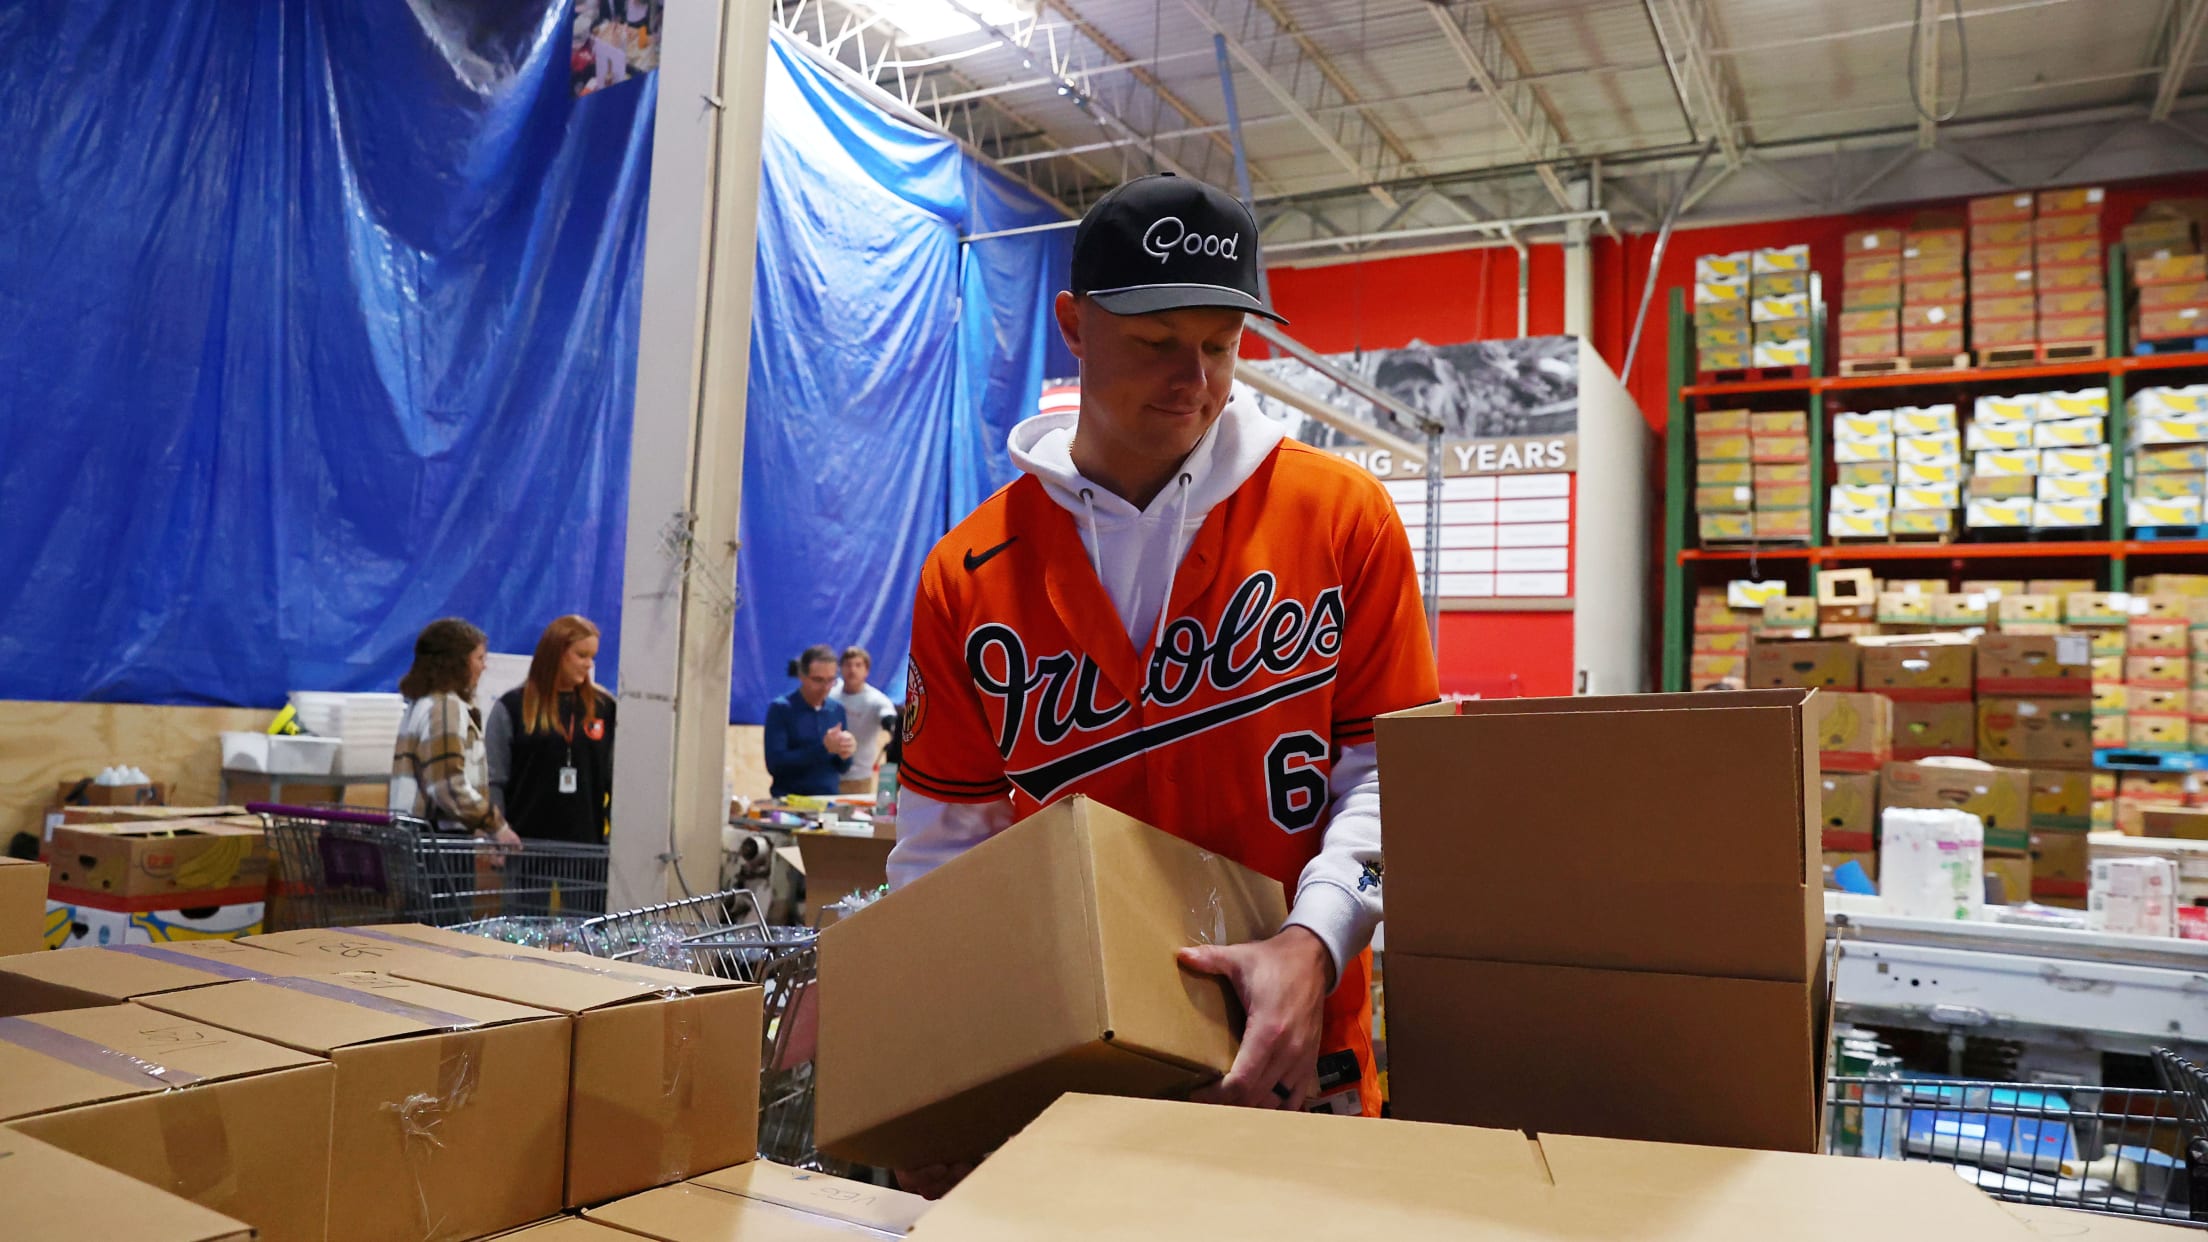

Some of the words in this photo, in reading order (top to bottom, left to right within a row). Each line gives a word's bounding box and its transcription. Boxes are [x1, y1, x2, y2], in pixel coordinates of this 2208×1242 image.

[1142, 216, 1239, 264] Good
[1453, 439, 1567, 472] YEARS
[1264, 730, 1329, 834] 6
